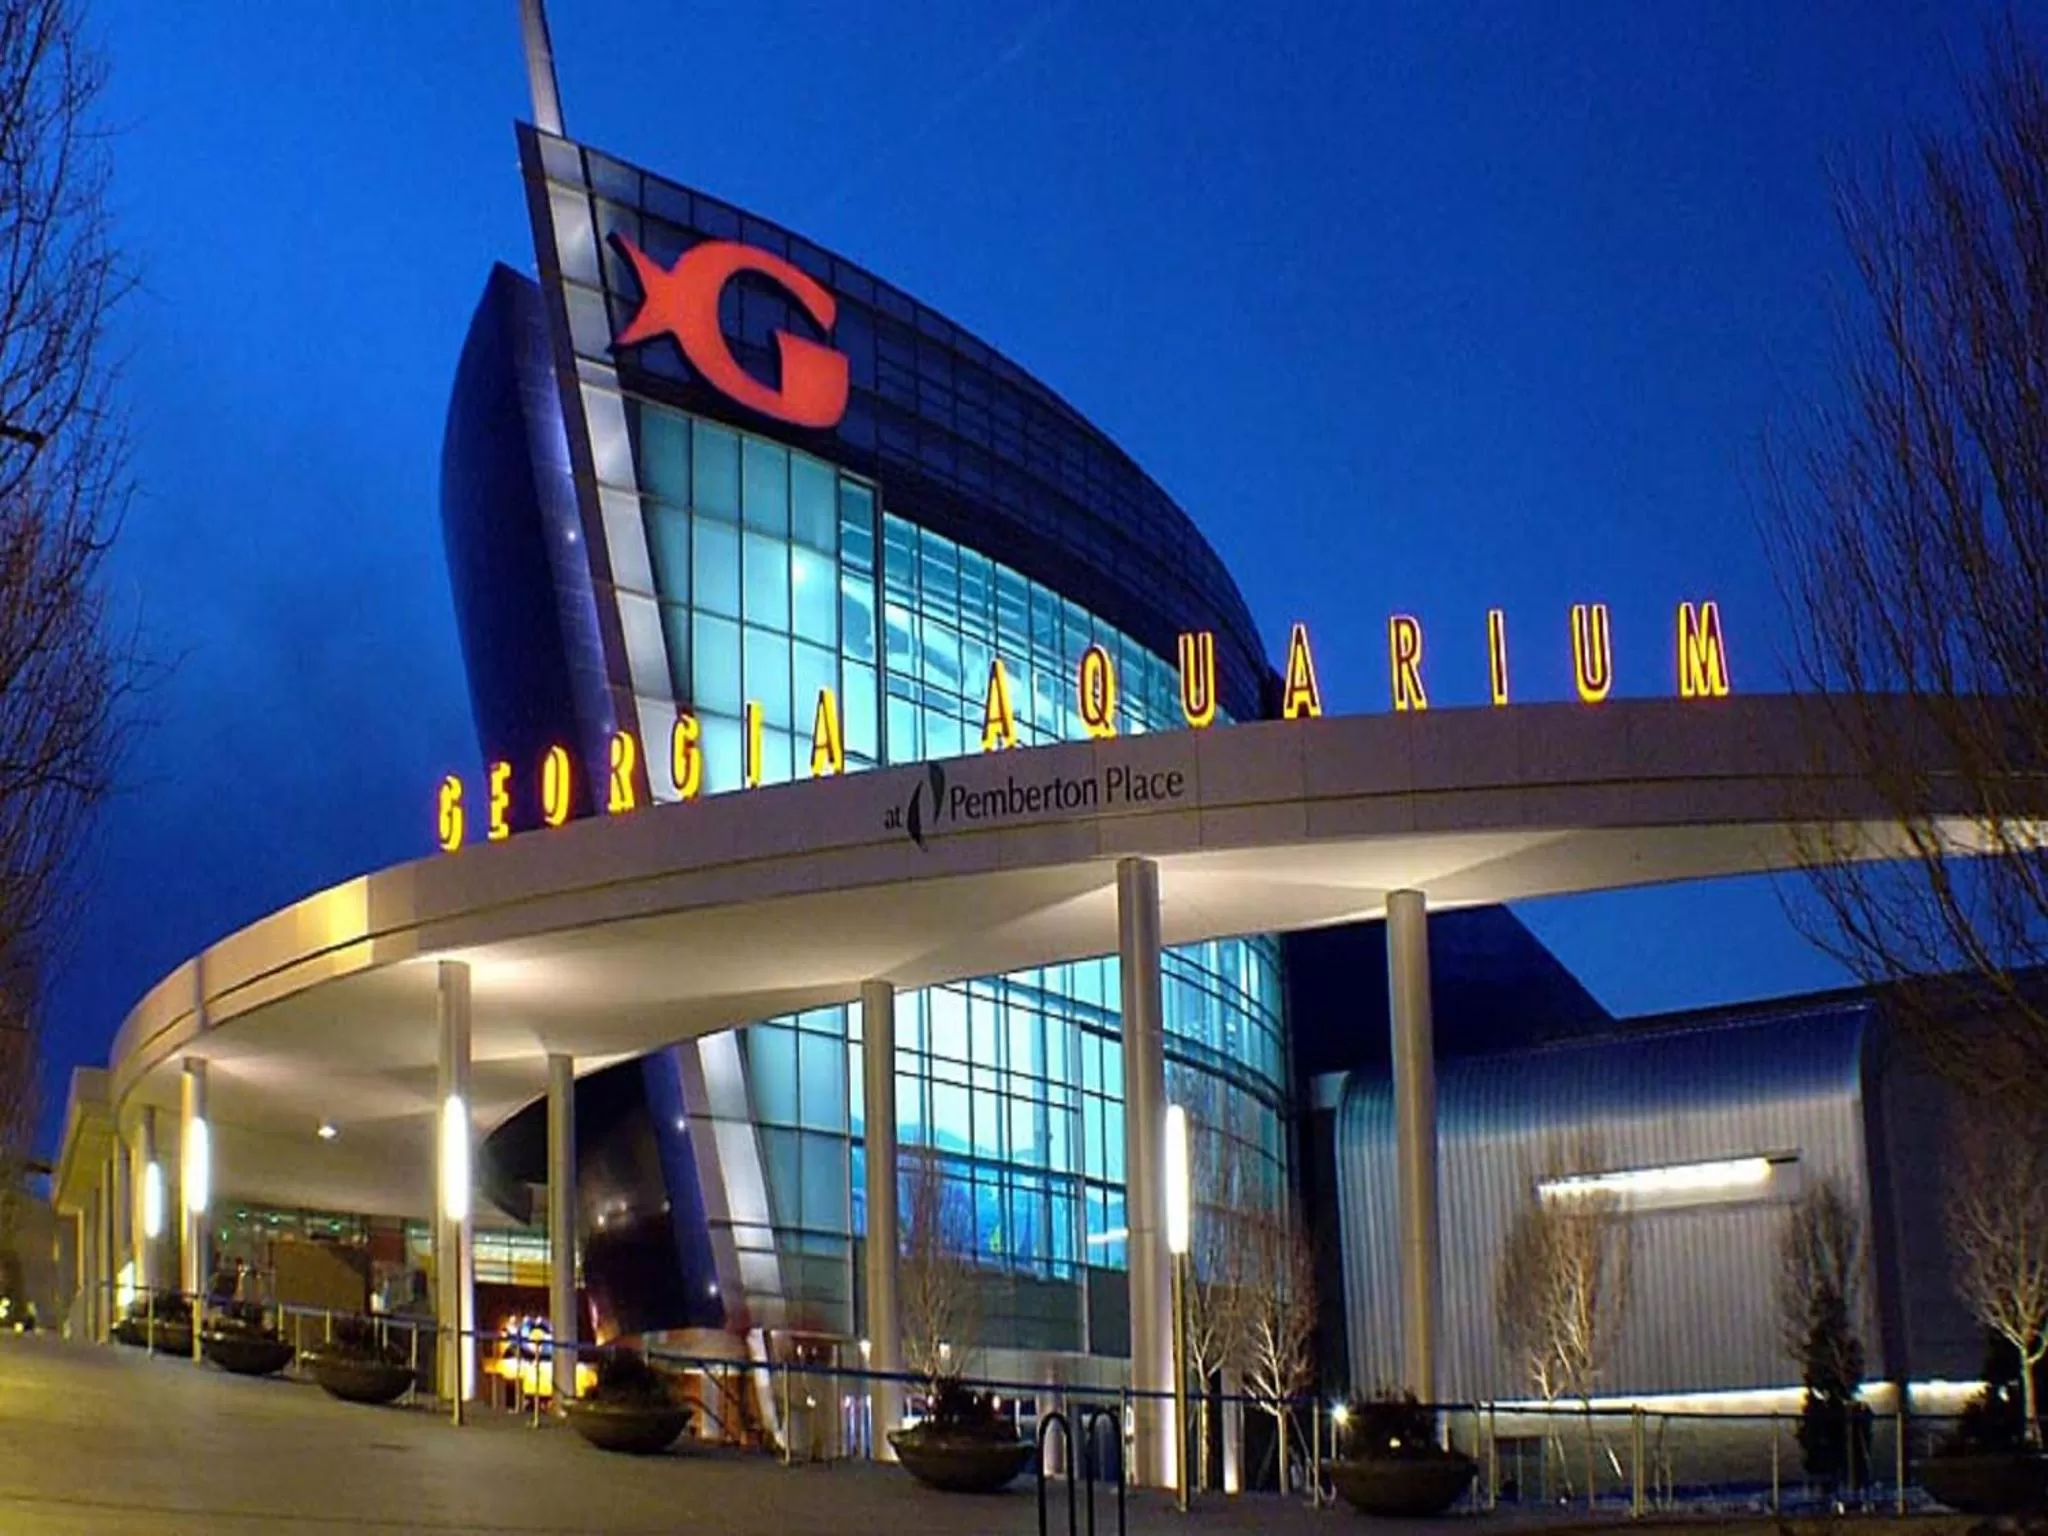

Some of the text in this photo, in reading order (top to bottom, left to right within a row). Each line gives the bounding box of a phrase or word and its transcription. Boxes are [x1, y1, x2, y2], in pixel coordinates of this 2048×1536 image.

[437, 601, 1730, 852] GEORGIA AQUARIUM
[884, 765, 1184, 830] at Pemberton Place
